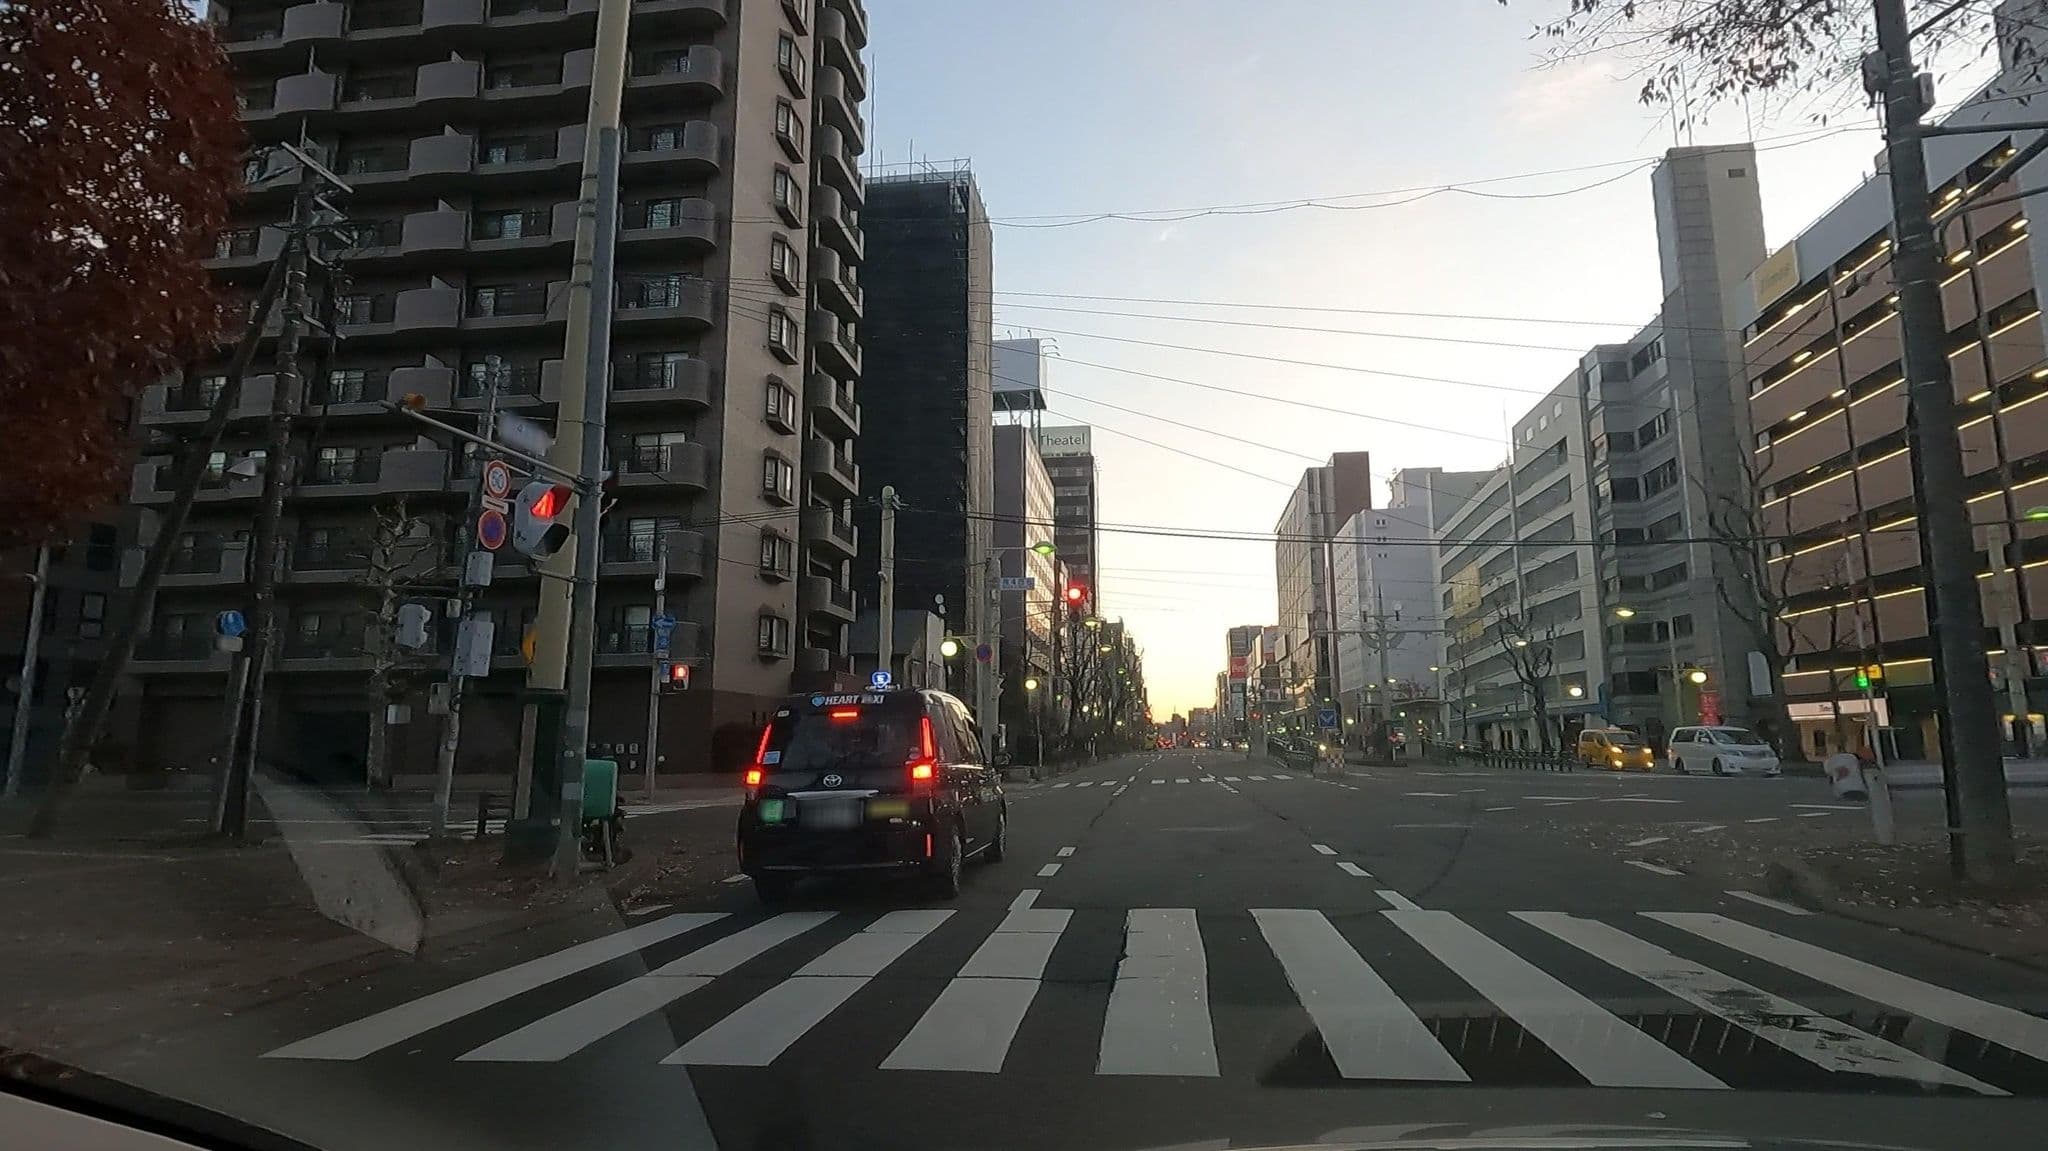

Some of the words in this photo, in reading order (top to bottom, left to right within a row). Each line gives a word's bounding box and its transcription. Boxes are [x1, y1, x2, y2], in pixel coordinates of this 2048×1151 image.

[1040, 433, 1085, 446] Theatel
[825, 695, 860, 705] HEART
[861, 695, 884, 704] XI
